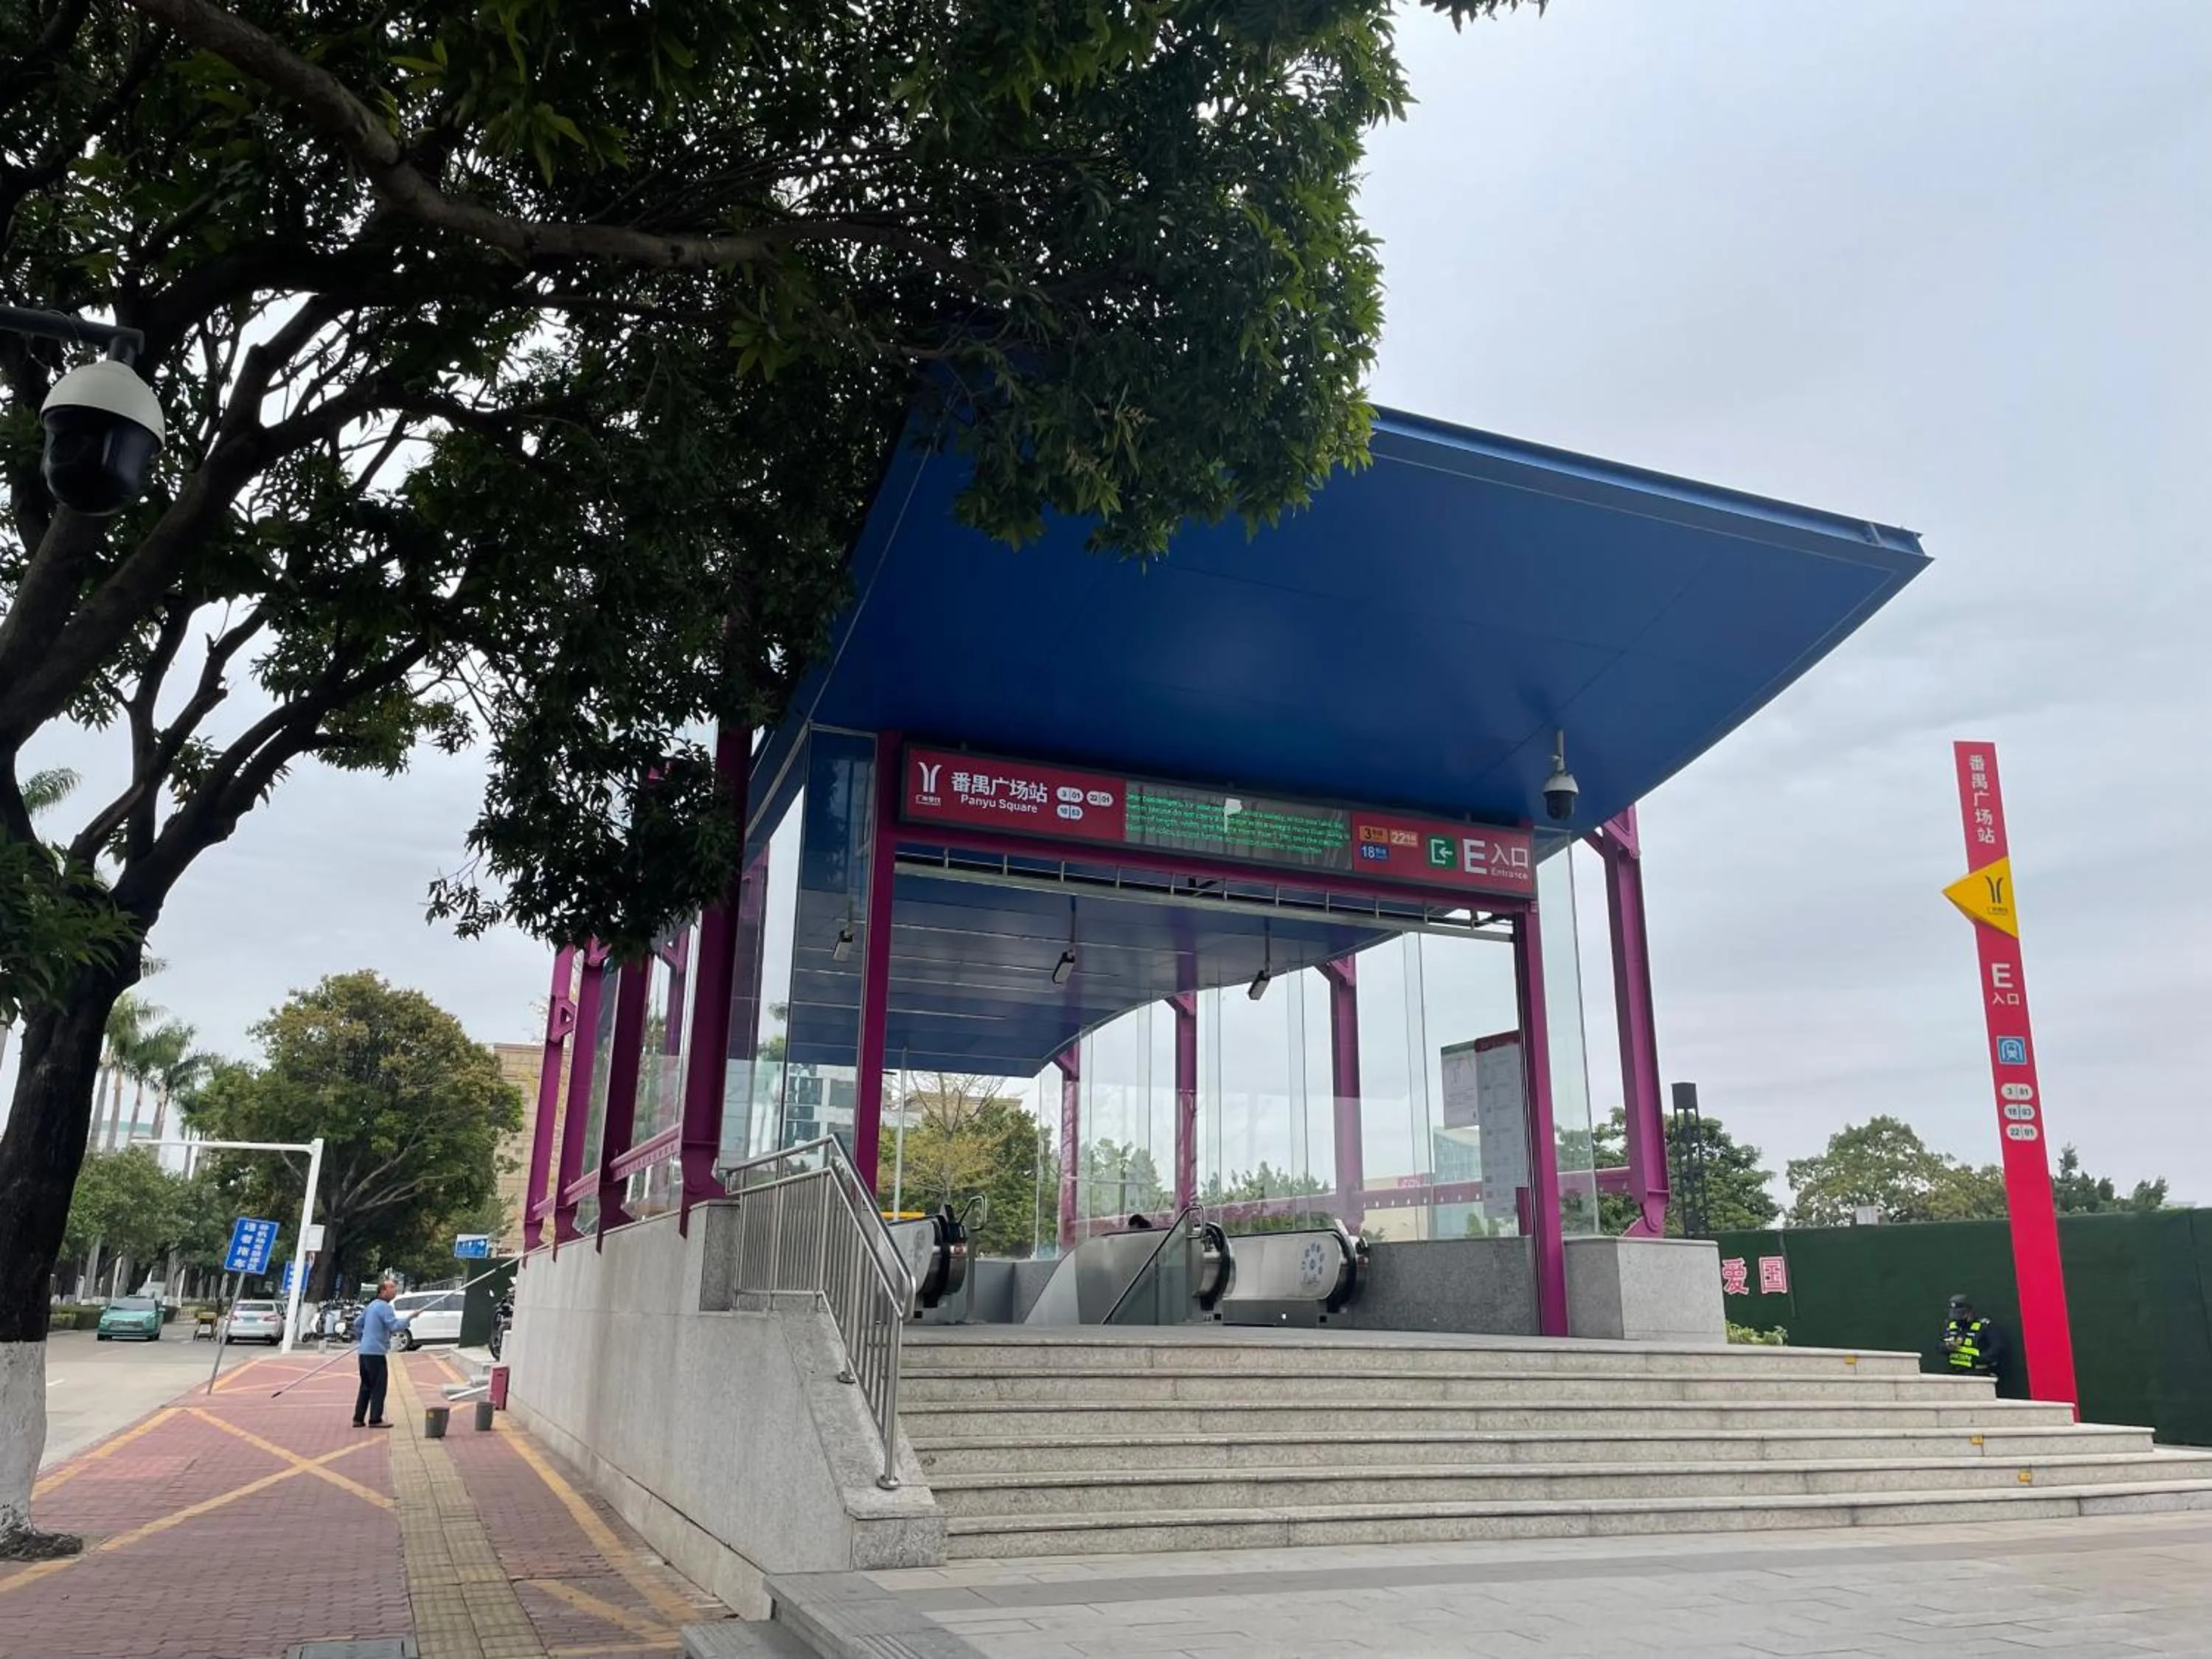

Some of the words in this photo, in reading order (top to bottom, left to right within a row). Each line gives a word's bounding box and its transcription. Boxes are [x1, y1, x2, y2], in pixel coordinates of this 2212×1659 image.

[951, 772, 1048, 803] 番禺广场站
[1969, 754, 1994, 844] 番禺广场站
[961, 794, 996, 809] Panyu
[998, 799, 1038, 813] Square
[1463, 839, 1487, 874] E
[1491, 844, 1529, 869] 入口
[1491, 866, 1528, 880] Entrance
[1992, 963, 2014, 987] E
[1992, 992, 2020, 1005] 入口
[1722, 1256, 1788, 1295] 爱国
